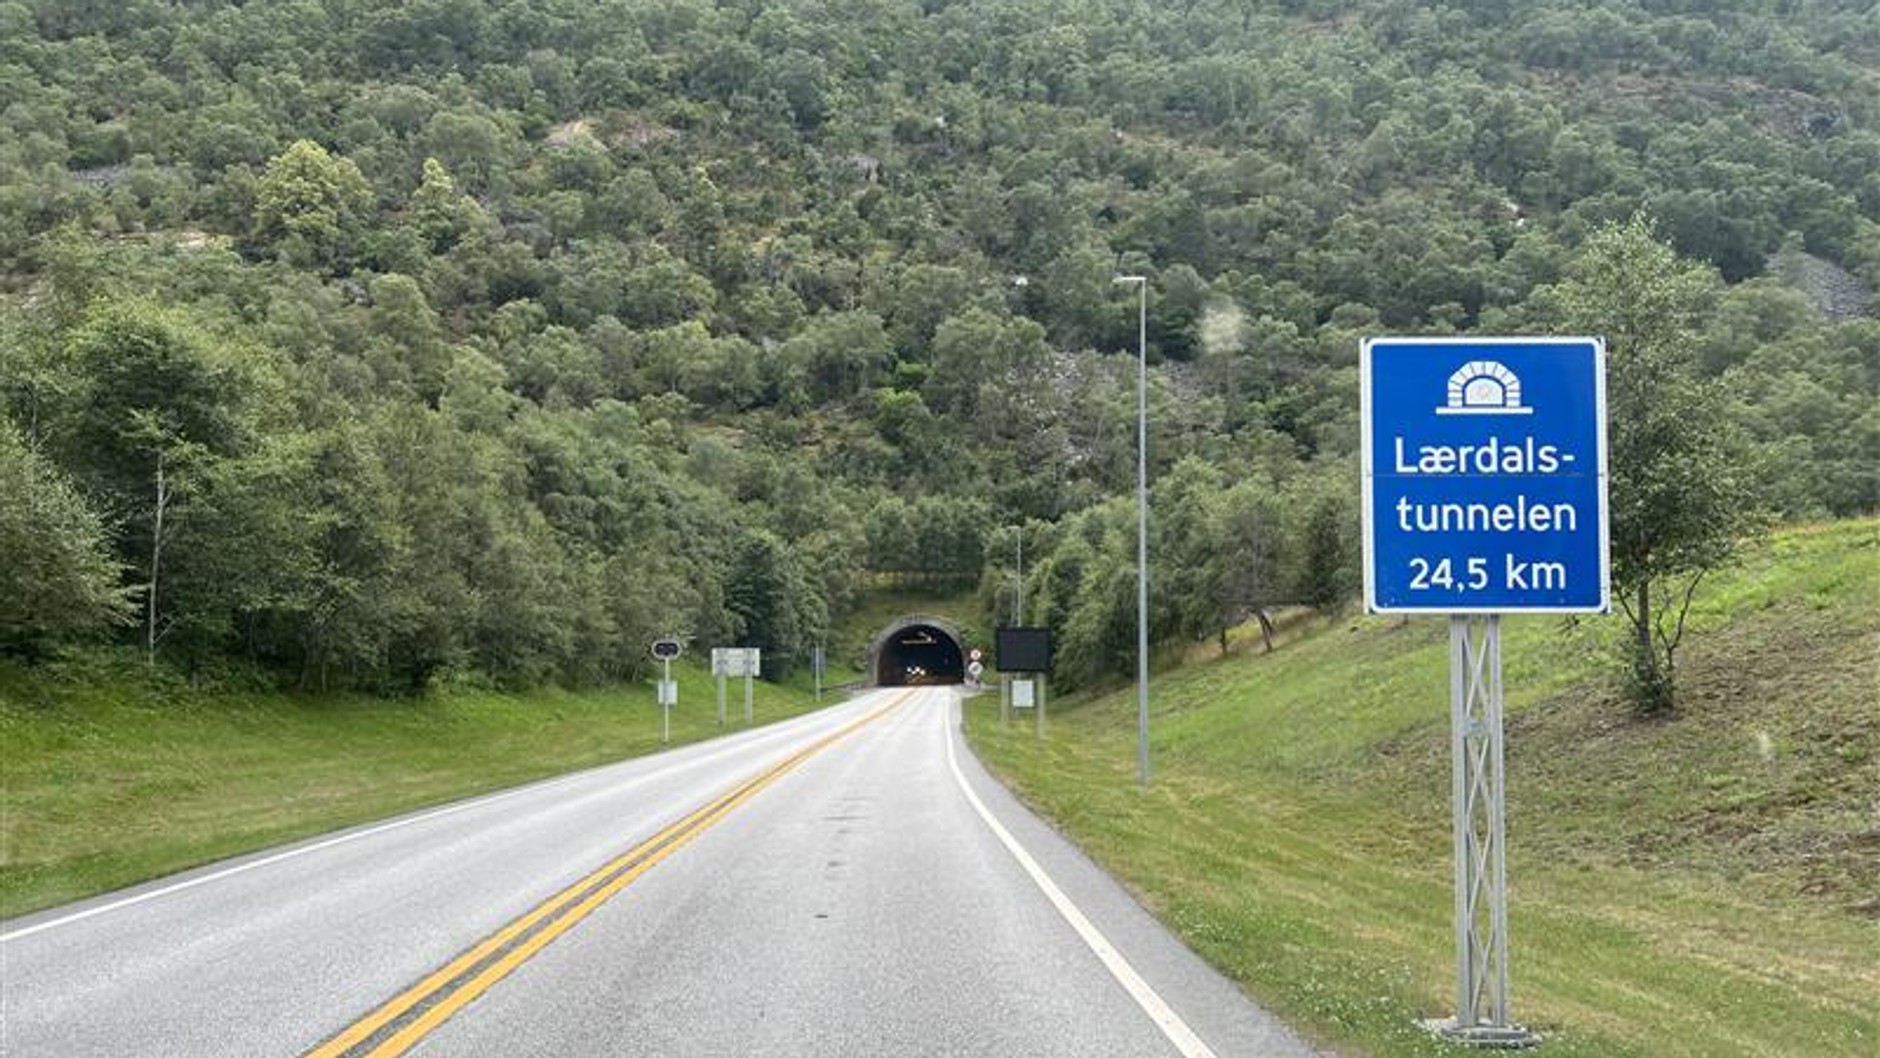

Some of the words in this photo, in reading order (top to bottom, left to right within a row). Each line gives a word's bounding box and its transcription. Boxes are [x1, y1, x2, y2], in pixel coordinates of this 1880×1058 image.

[1395, 436, 1575, 473] Lærdals-
[1396, 495, 1577, 531] tunnelen
[1409, 558, 1488, 593] 24,5
[1506, 553, 1566, 590] km
